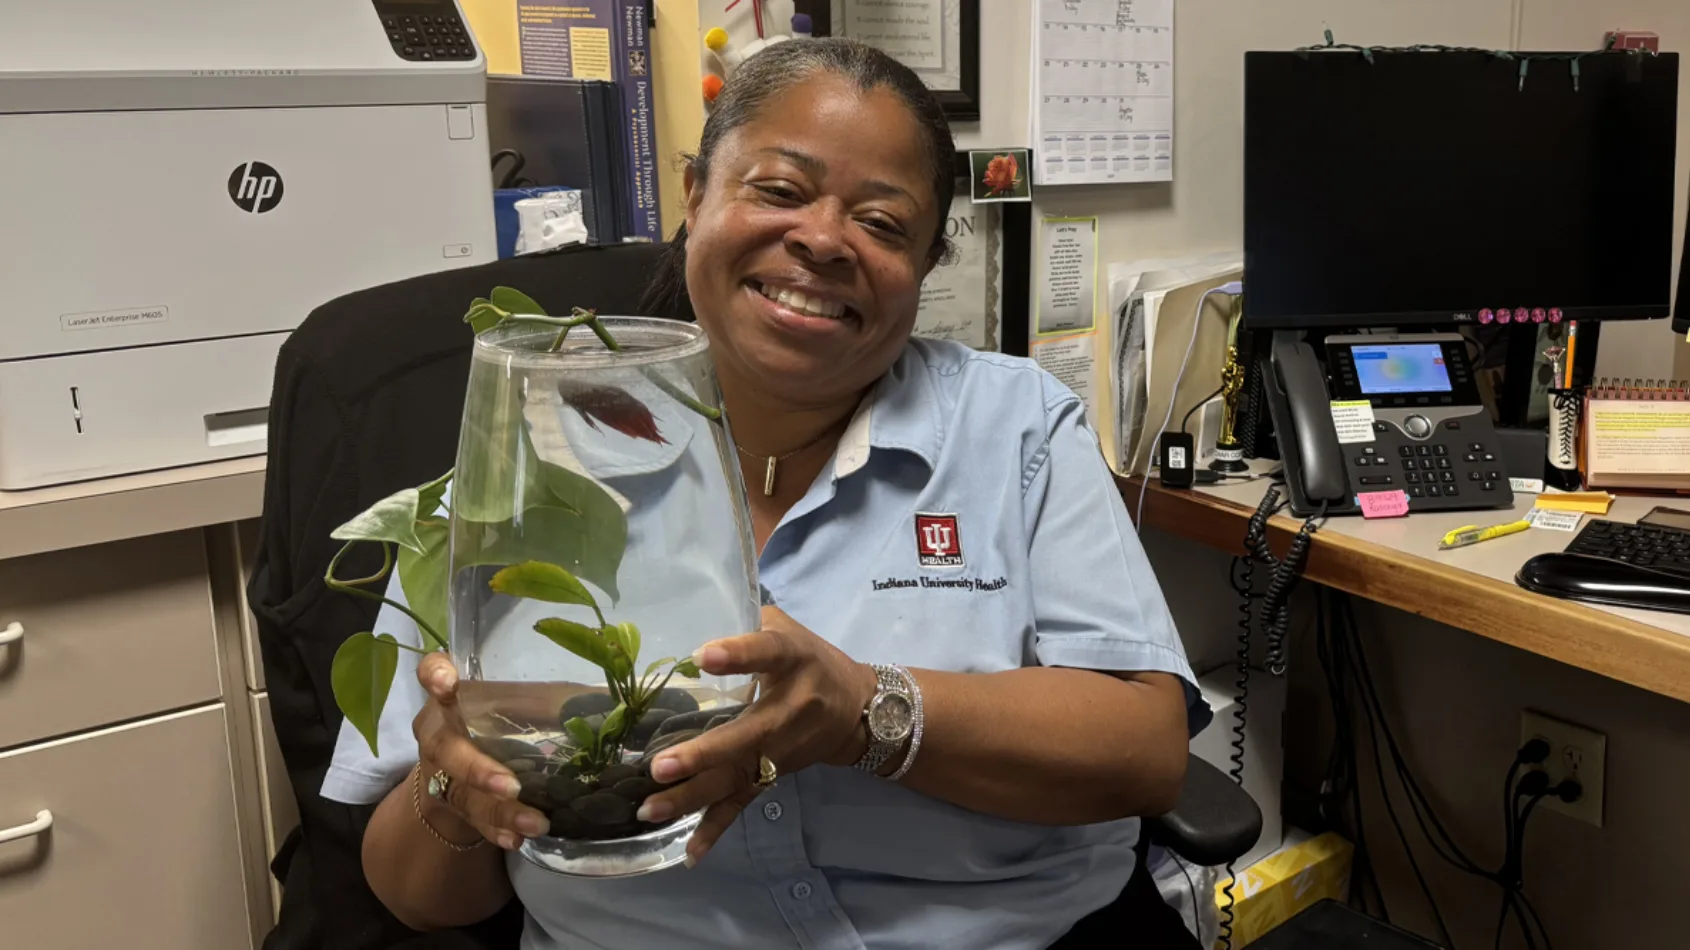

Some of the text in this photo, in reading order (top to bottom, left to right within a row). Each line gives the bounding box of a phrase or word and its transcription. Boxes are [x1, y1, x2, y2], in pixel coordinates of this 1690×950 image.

[625, 6, 635, 47] Newman
[635, 6, 645, 47] Newman
[637, 81, 657, 232] Development Through Life
[234, 161, 279, 213] hp
[67, 316, 100, 327] LaserJet
[101, 313, 140, 324] Enterprise
[921, 556, 961, 565] HEALTH
[872, 576, 1008, 591] Indiana University Health
